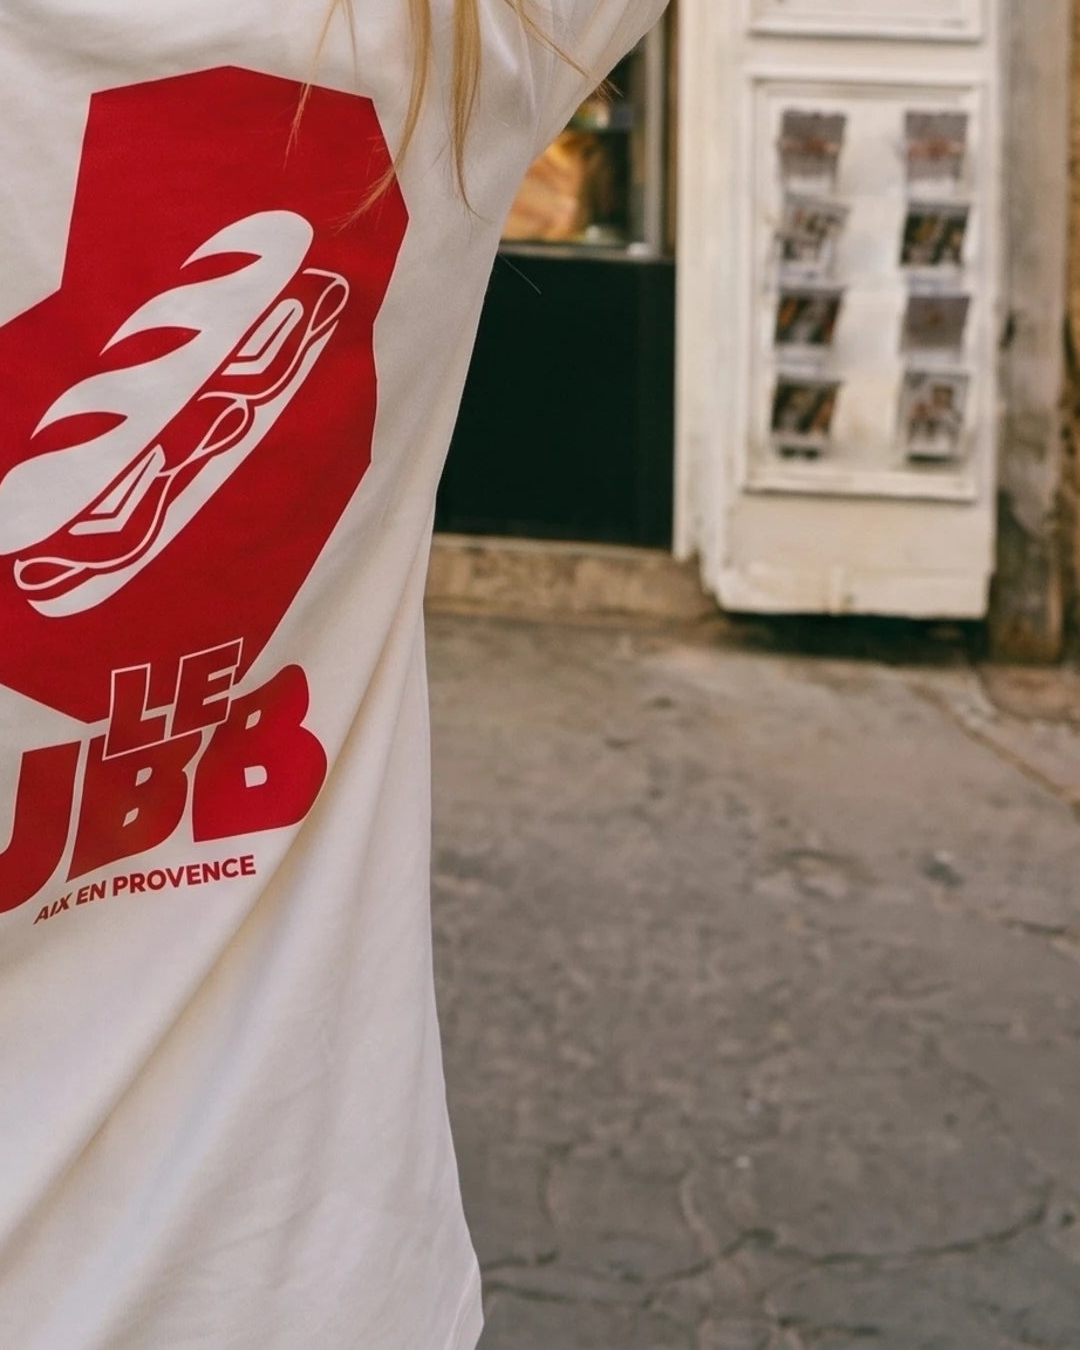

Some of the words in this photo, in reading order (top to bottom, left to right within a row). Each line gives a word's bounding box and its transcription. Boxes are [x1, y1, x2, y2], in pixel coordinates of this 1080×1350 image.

[102, 637, 243, 761] LE
[33, 893, 72, 925] AIX
[75, 880, 106, 905] EN
[112, 854, 256, 897] PROVENCE
